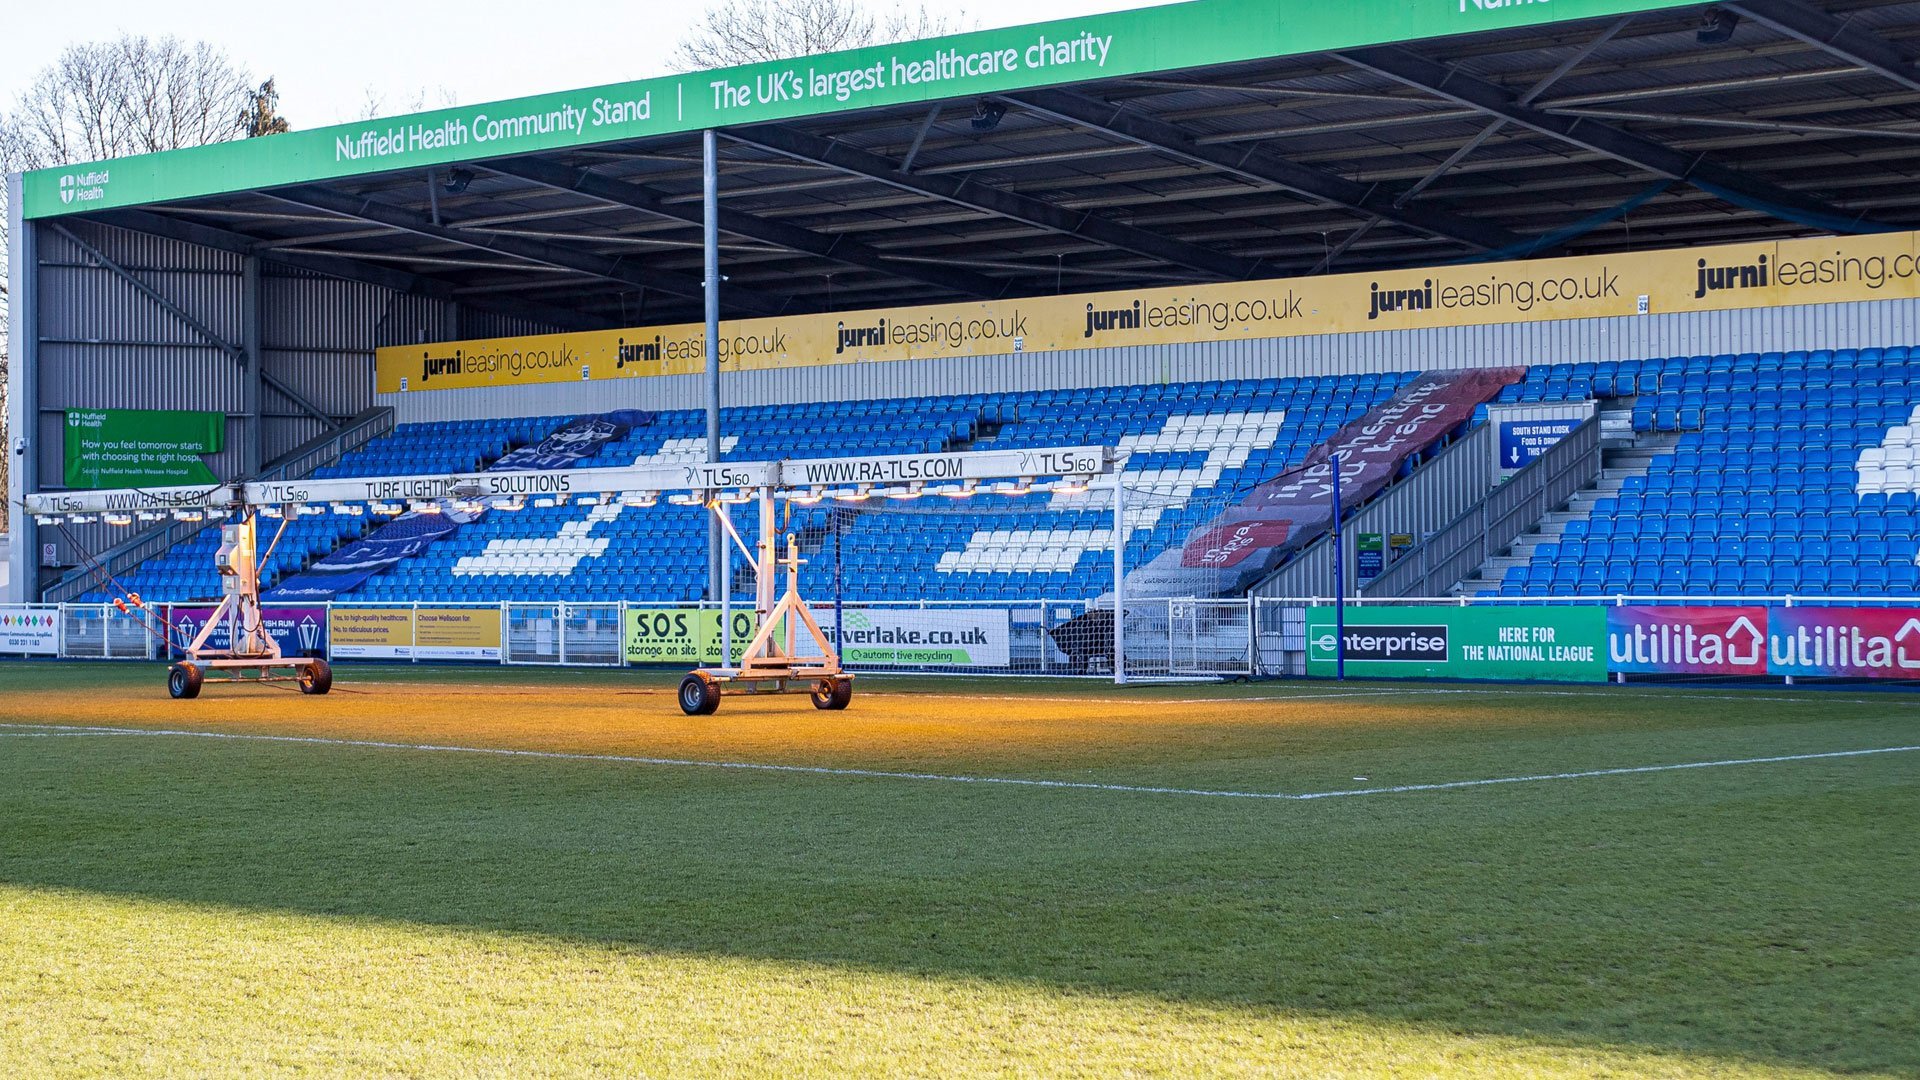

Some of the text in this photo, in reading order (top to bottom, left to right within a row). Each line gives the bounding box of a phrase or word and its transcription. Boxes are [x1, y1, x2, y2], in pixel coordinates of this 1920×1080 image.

[710, 30, 1113, 110] The UK's largest healthcare charity
[336, 90, 650, 162] Nuffield Health Community Stand
[76, 170, 109, 187] Nuffield
[77, 186, 104, 201] Health
[1512, 425, 1570, 435] SOUTH STAND KIOSK
[81, 440, 100, 448] How
[103, 442, 118, 450] you
[120, 440, 136, 449] feel
[180, 442, 203, 450] starts
[1537, 437, 1542, 445] &
[82, 452, 100, 460] with
[101, 452, 139, 463] choosing
[141, 453, 154, 461] the
[156, 453, 175, 463] right
[1527, 448, 1540, 456] THIS
[806, 458, 963, 483] WWW.RA-TLS.COM
[366, 482, 399, 498] TURF
[491, 475, 570, 494] SOLUTIONS
[105, 490, 212, 509] WWW.RA-TLS.COM
[278, 619, 295, 627] RUM
[637, 613, 688, 637] SOS
[1499, 627, 1555, 643] HERE FOR
[628, 644, 697, 658] storage on site
[1610, 623, 1723, 665] utilita
[1771, 625, 1892, 667] utilita
[706, 646, 742, 659] storge
[863, 651, 953, 662] automotive recycling
[1462, 646, 1594, 662] THE NATIONAL LEAGUE
